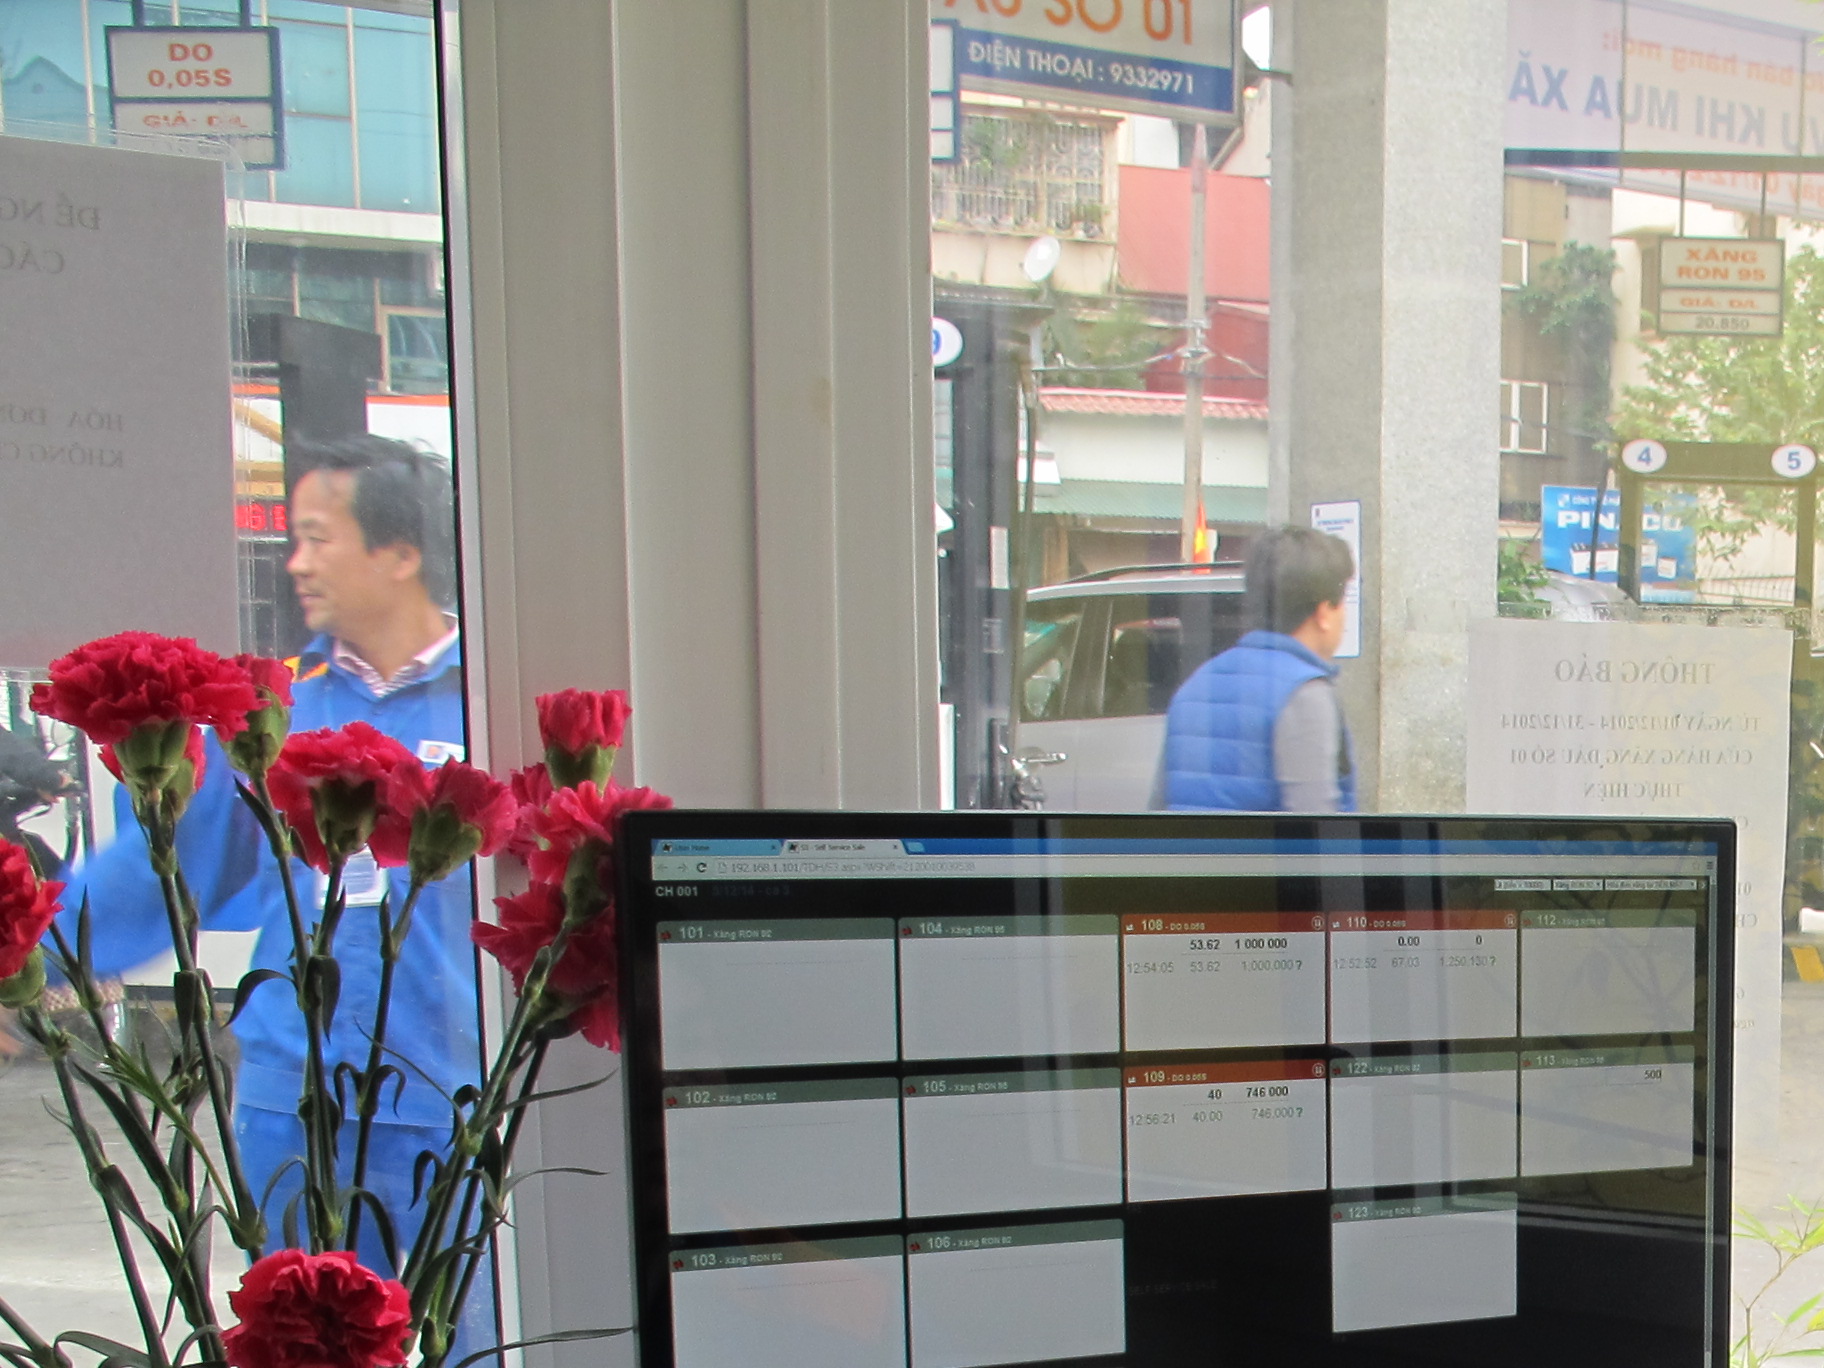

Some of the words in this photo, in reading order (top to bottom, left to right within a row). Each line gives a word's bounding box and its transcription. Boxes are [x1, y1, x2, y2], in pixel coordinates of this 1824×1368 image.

[168, 43, 213, 62] DO
[968, 40, 1022, 72] ĐIỆN
[1027, 50, 1094, 83] THOẠI
[1110, 62, 1194, 95] 9332971
[147, 68, 232, 89] 0,05S
[1637, 446, 1653, 467] 4
[1786, 451, 1802, 471] 5
[655, 886, 674, 897] CH
[677, 886, 699, 897] 001
[1141, 919, 1163, 931] 108
[1347, 916, 1368, 928] 110
[1537, 914, 1556, 926] 112
[680, 926, 704, 939] 101
[919, 922, 943, 935] 104
[1190, 939, 1220, 950] 53.62
[1397, 936, 1421, 947] 0.00
[1475, 934, 1483, 946] 0
[1190, 961, 1221, 973] 53.62
[1536, 1055, 1555, 1066] 113
[1347, 1062, 1368, 1075] 122
[1143, 1071, 1165, 1083] 109
[923, 1081, 946, 1093] 105
[685, 1091, 710, 1104] 102
[1207, 1089, 1222, 1100] 40
[1192, 1110, 1223, 1122] 40.00
[1349, 1207, 1368, 1219] 123
[927, 1236, 950, 1249] 106
[692, 1253, 717, 1267] 103
